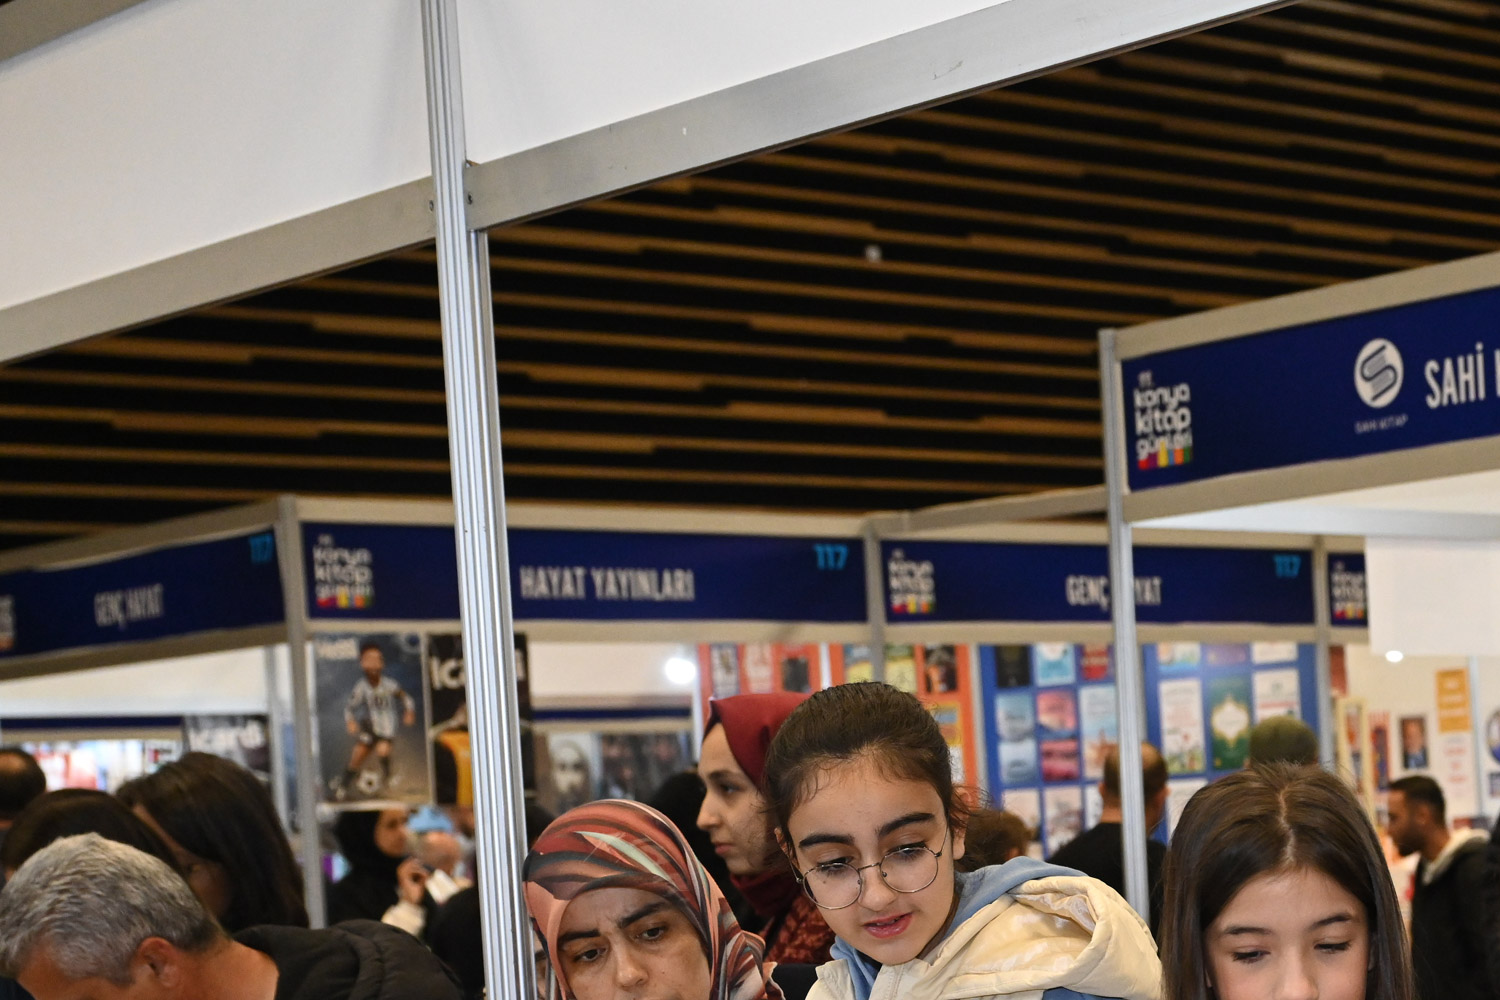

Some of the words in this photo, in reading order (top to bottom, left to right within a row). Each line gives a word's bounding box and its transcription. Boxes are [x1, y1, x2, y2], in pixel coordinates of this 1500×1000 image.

[1425, 342, 1486, 409] SAHİ
[1133, 383, 1191, 408] konya
[1134, 405, 1192, 435] kitap
[813, 543, 849, 570] 117
[519, 565, 586, 598] HAYAT
[591, 566, 695, 602] YAYINLARI
[1065, 574, 1109, 611] GENÇ
